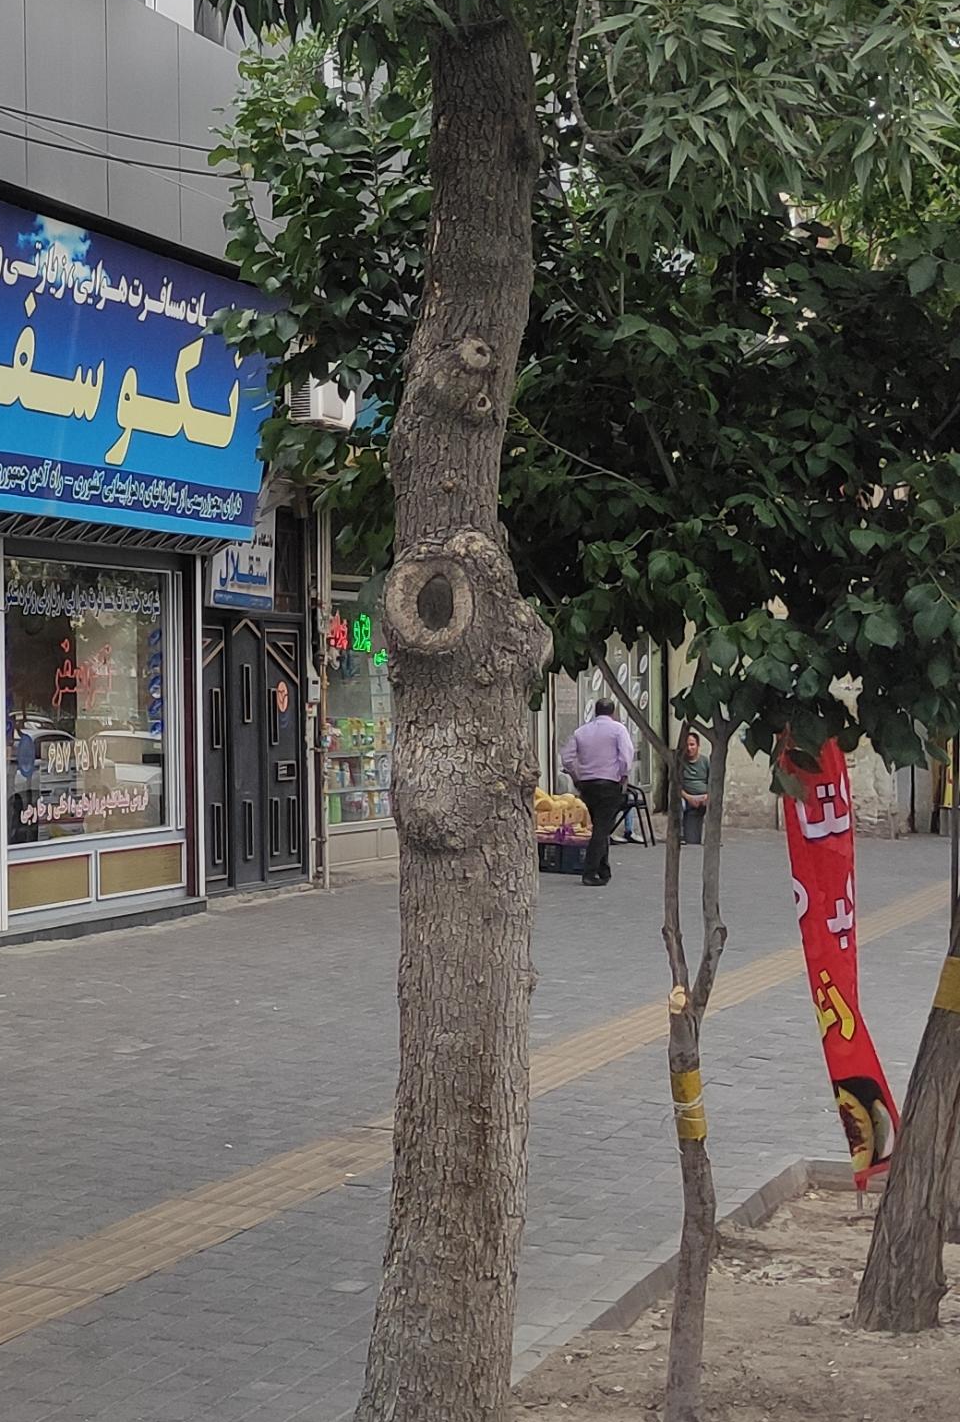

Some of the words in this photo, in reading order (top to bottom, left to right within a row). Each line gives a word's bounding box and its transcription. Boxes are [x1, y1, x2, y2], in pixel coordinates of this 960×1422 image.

[3, 241, 68, 300] زیارتی
[127, 277, 187, 322] مسافرت
[104, 337, 242, 465] نکو
[28, 459, 52, 492] آهن
[49, 463, 63, 497] راه
[219, 547, 272, 587] استقلال
[47, 741, 71, 774] ۶۵۷
